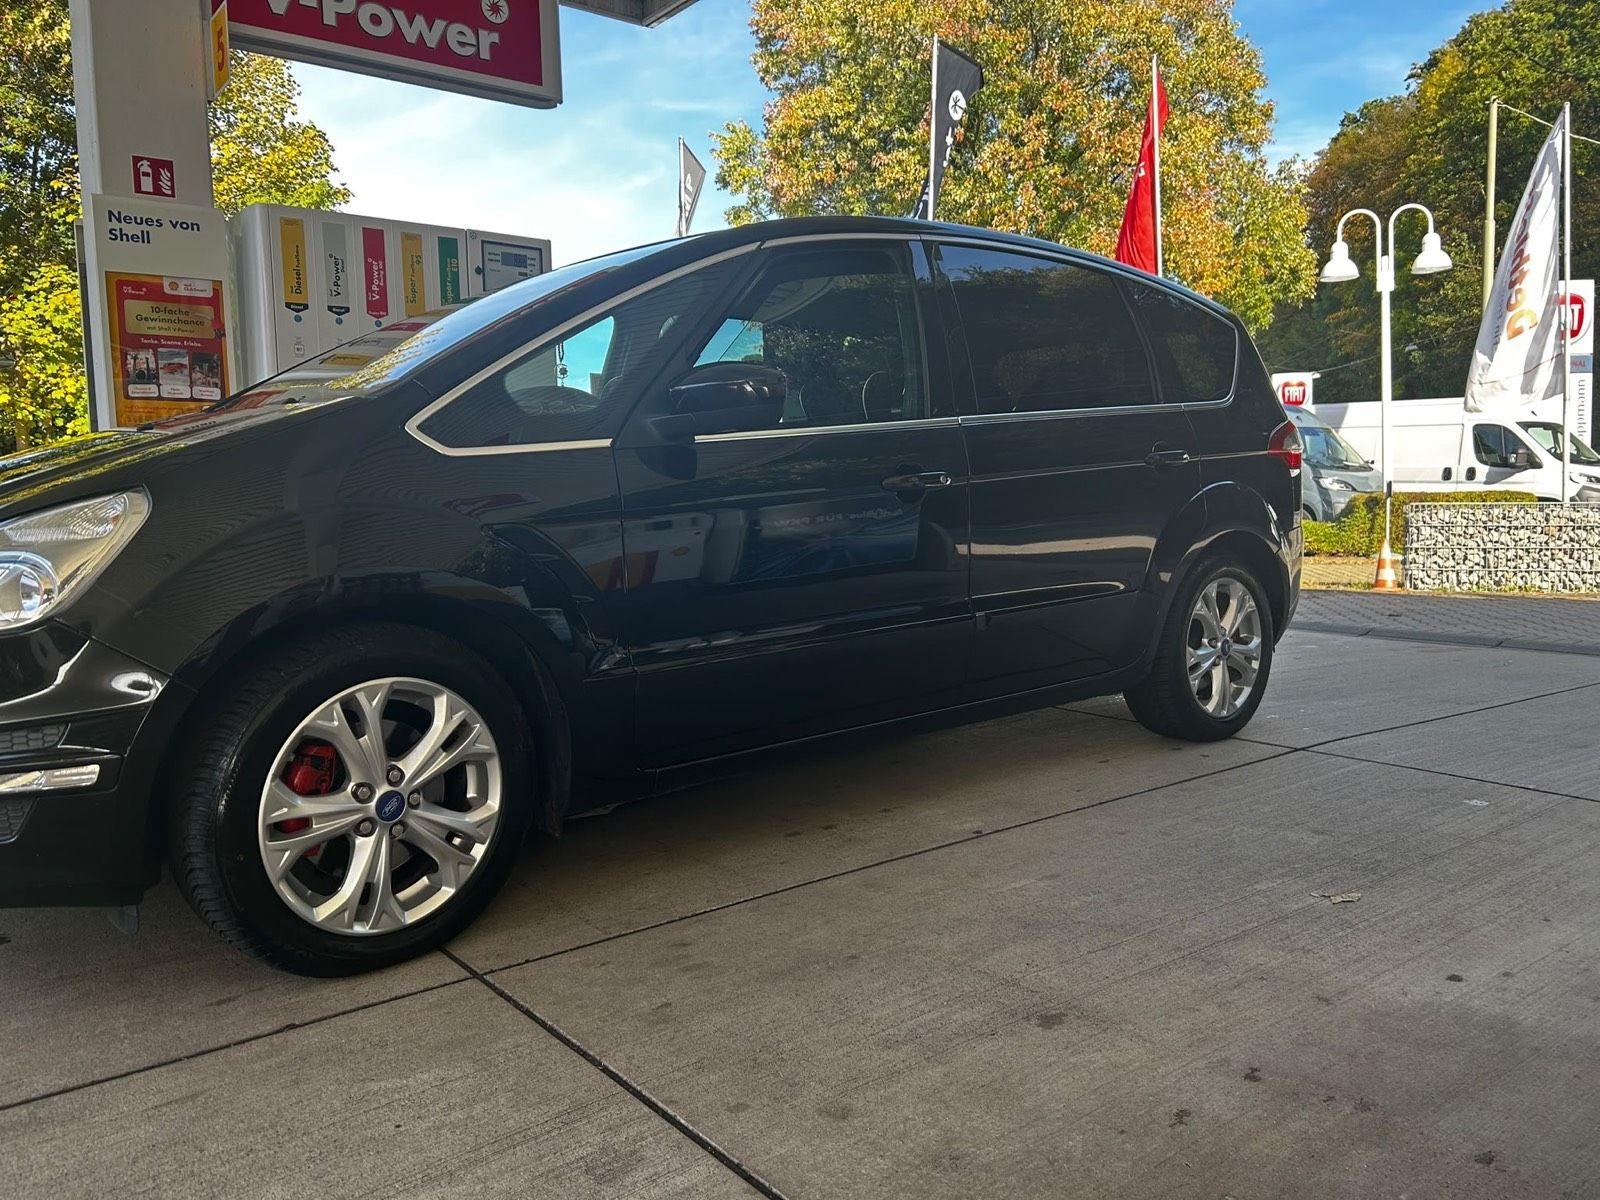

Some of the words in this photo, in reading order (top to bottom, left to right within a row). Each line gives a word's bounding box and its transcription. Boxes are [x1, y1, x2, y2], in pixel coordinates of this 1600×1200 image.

[216, 27, 226, 73] 5
[107, 209, 164, 228] Neues
[169, 219, 201, 232] von
[108, 227, 151, 245] Shell
[415, 254, 422, 265] 95
[293, 268, 303, 295] Diesel
[332, 256, 342, 297] V-Power
[371, 260, 380, 300] V-Power
[409, 277, 419, 304] Super
[135, 314, 205, 327] Gewinnchance
[150, 305, 190, 317] 10-fache
[1285, 386, 1304, 402] FIAT
